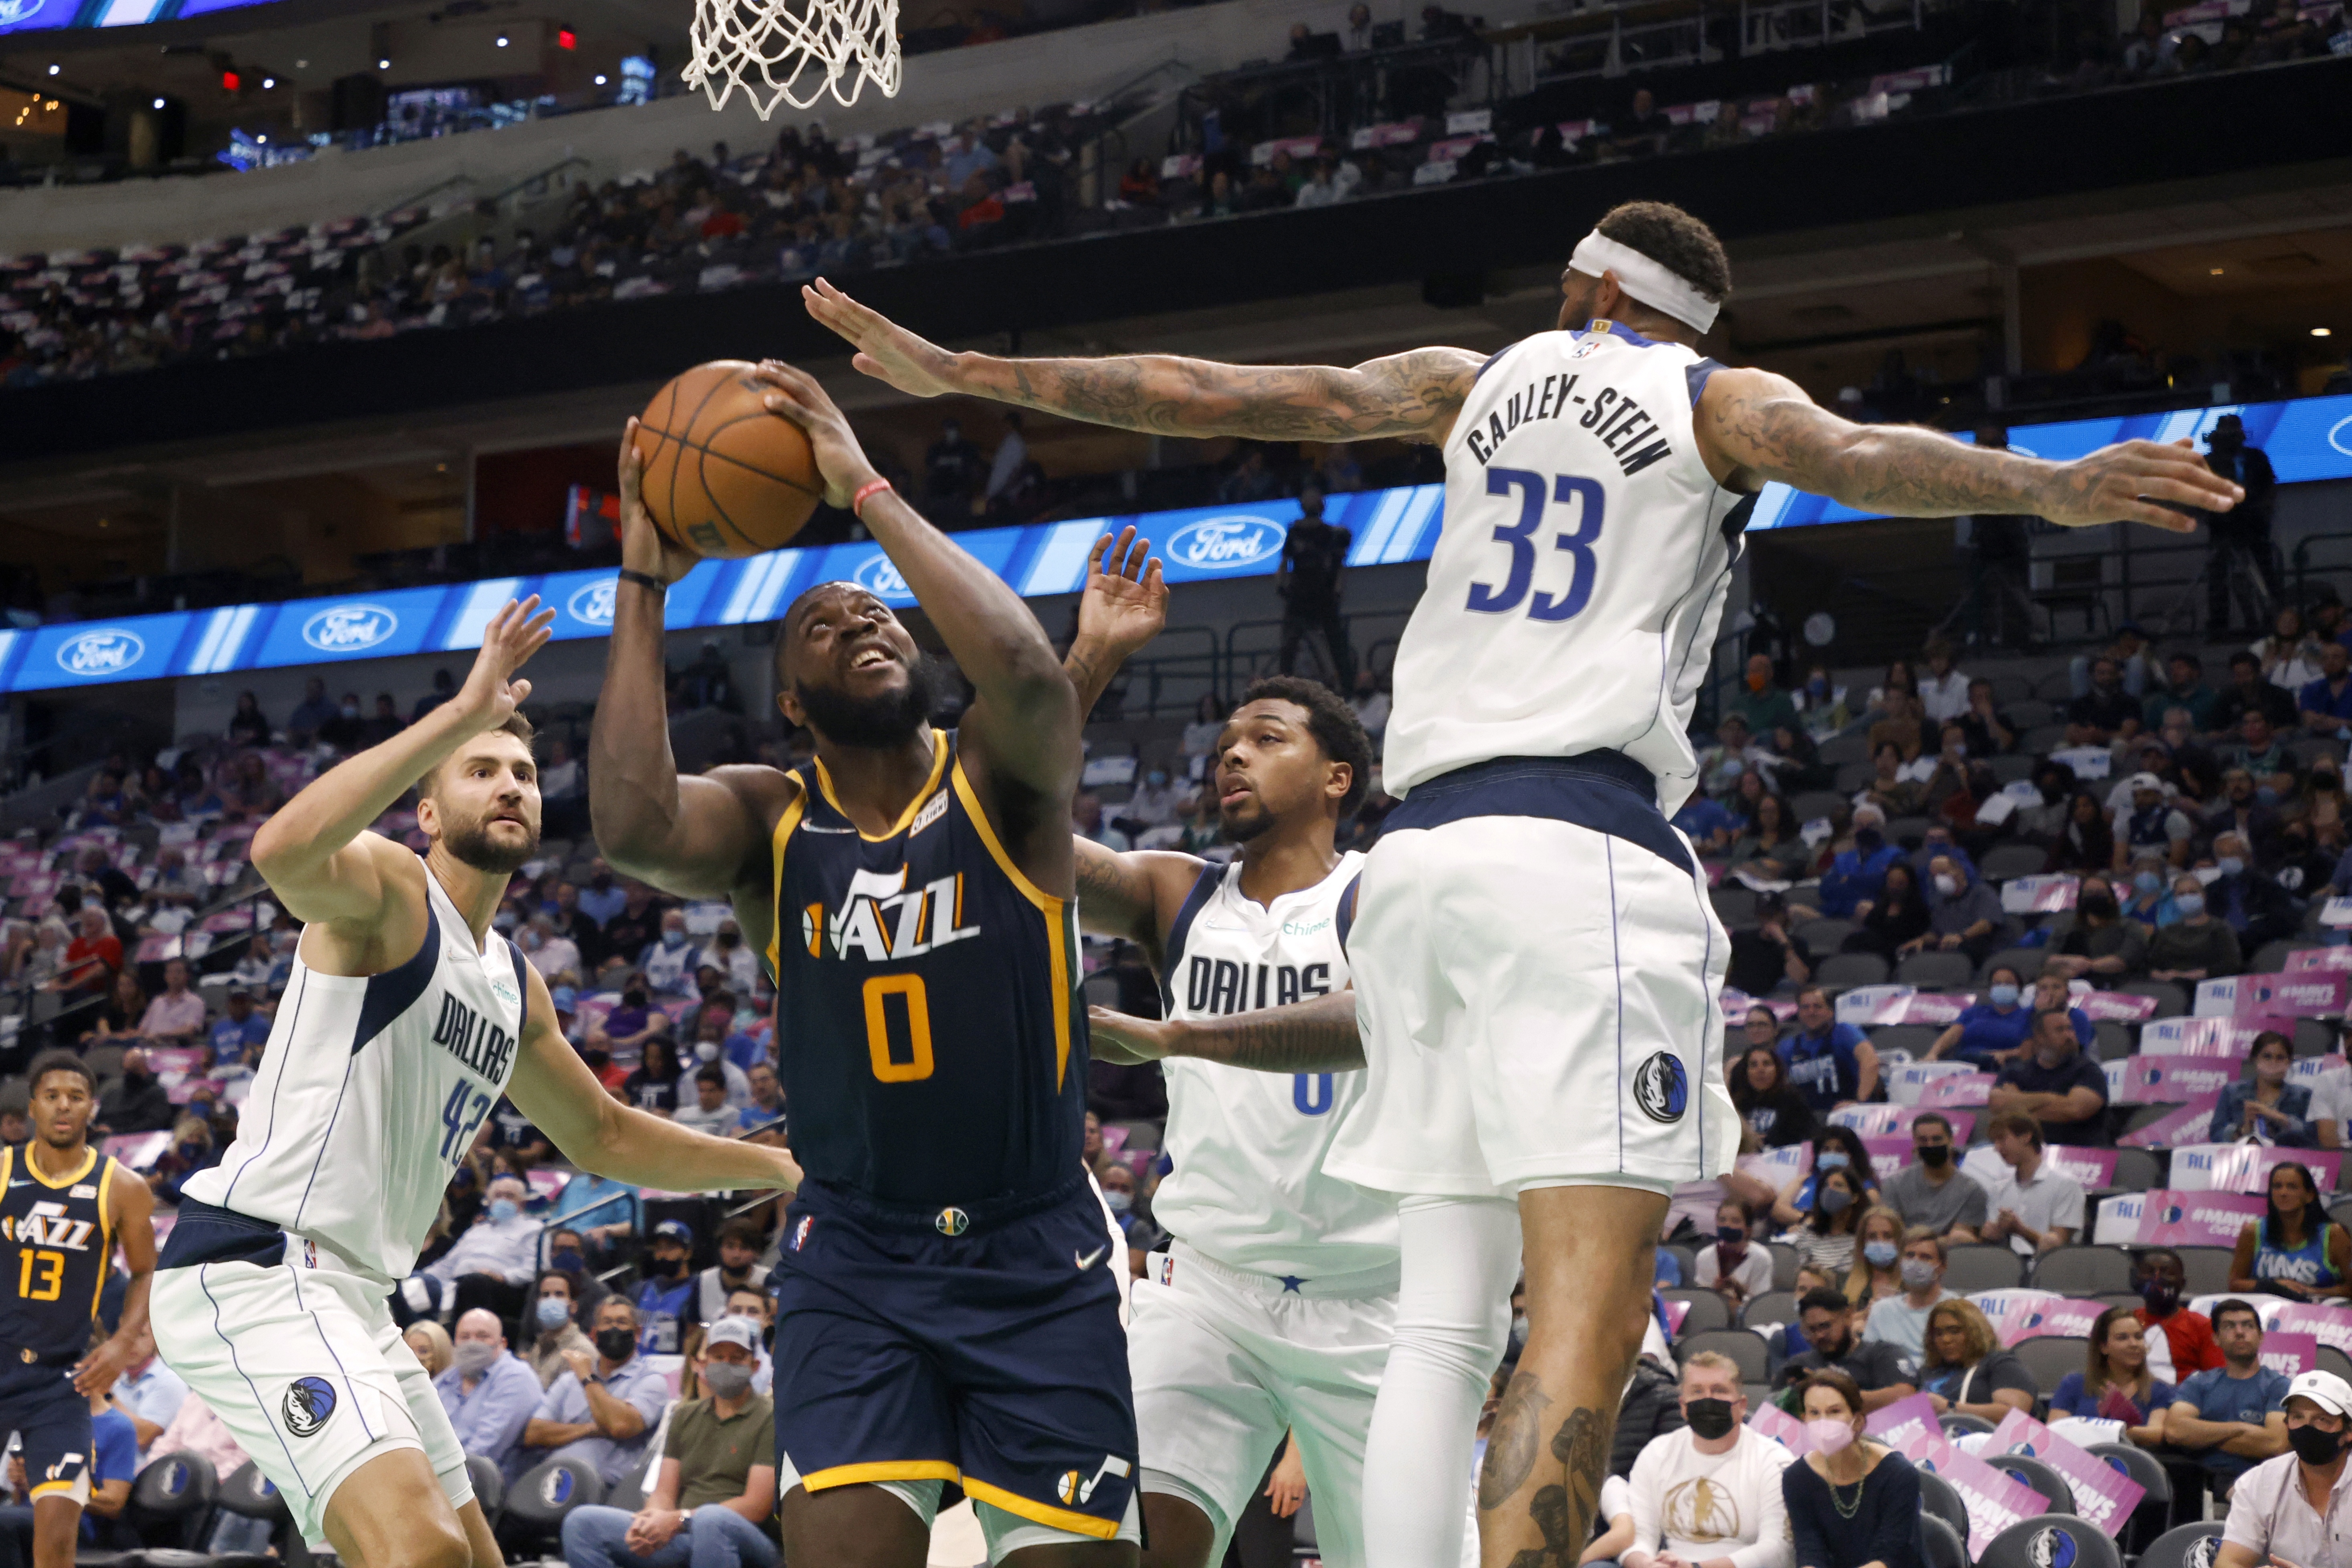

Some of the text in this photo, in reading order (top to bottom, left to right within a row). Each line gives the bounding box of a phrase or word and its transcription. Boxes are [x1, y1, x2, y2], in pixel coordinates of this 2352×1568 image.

[1467, 374, 1672, 477] CAULEY-STEIN
[1188, 523, 1264, 561] Ford
[1465, 466, 1606, 624] 33
[72, 636, 129, 669] Ford
[319, 610, 379, 645] Ford
[829, 863, 981, 961] JAZZ
[1283, 917, 1330, 936] chime
[493, 981, 519, 1005] chime
[432, 990, 515, 1086] DALLAS
[862, 973, 934, 1083] 0
[439, 1077, 492, 1168] 42
[15, 1201, 95, 1251] JAZZ
[18, 1249, 65, 1301] 13
